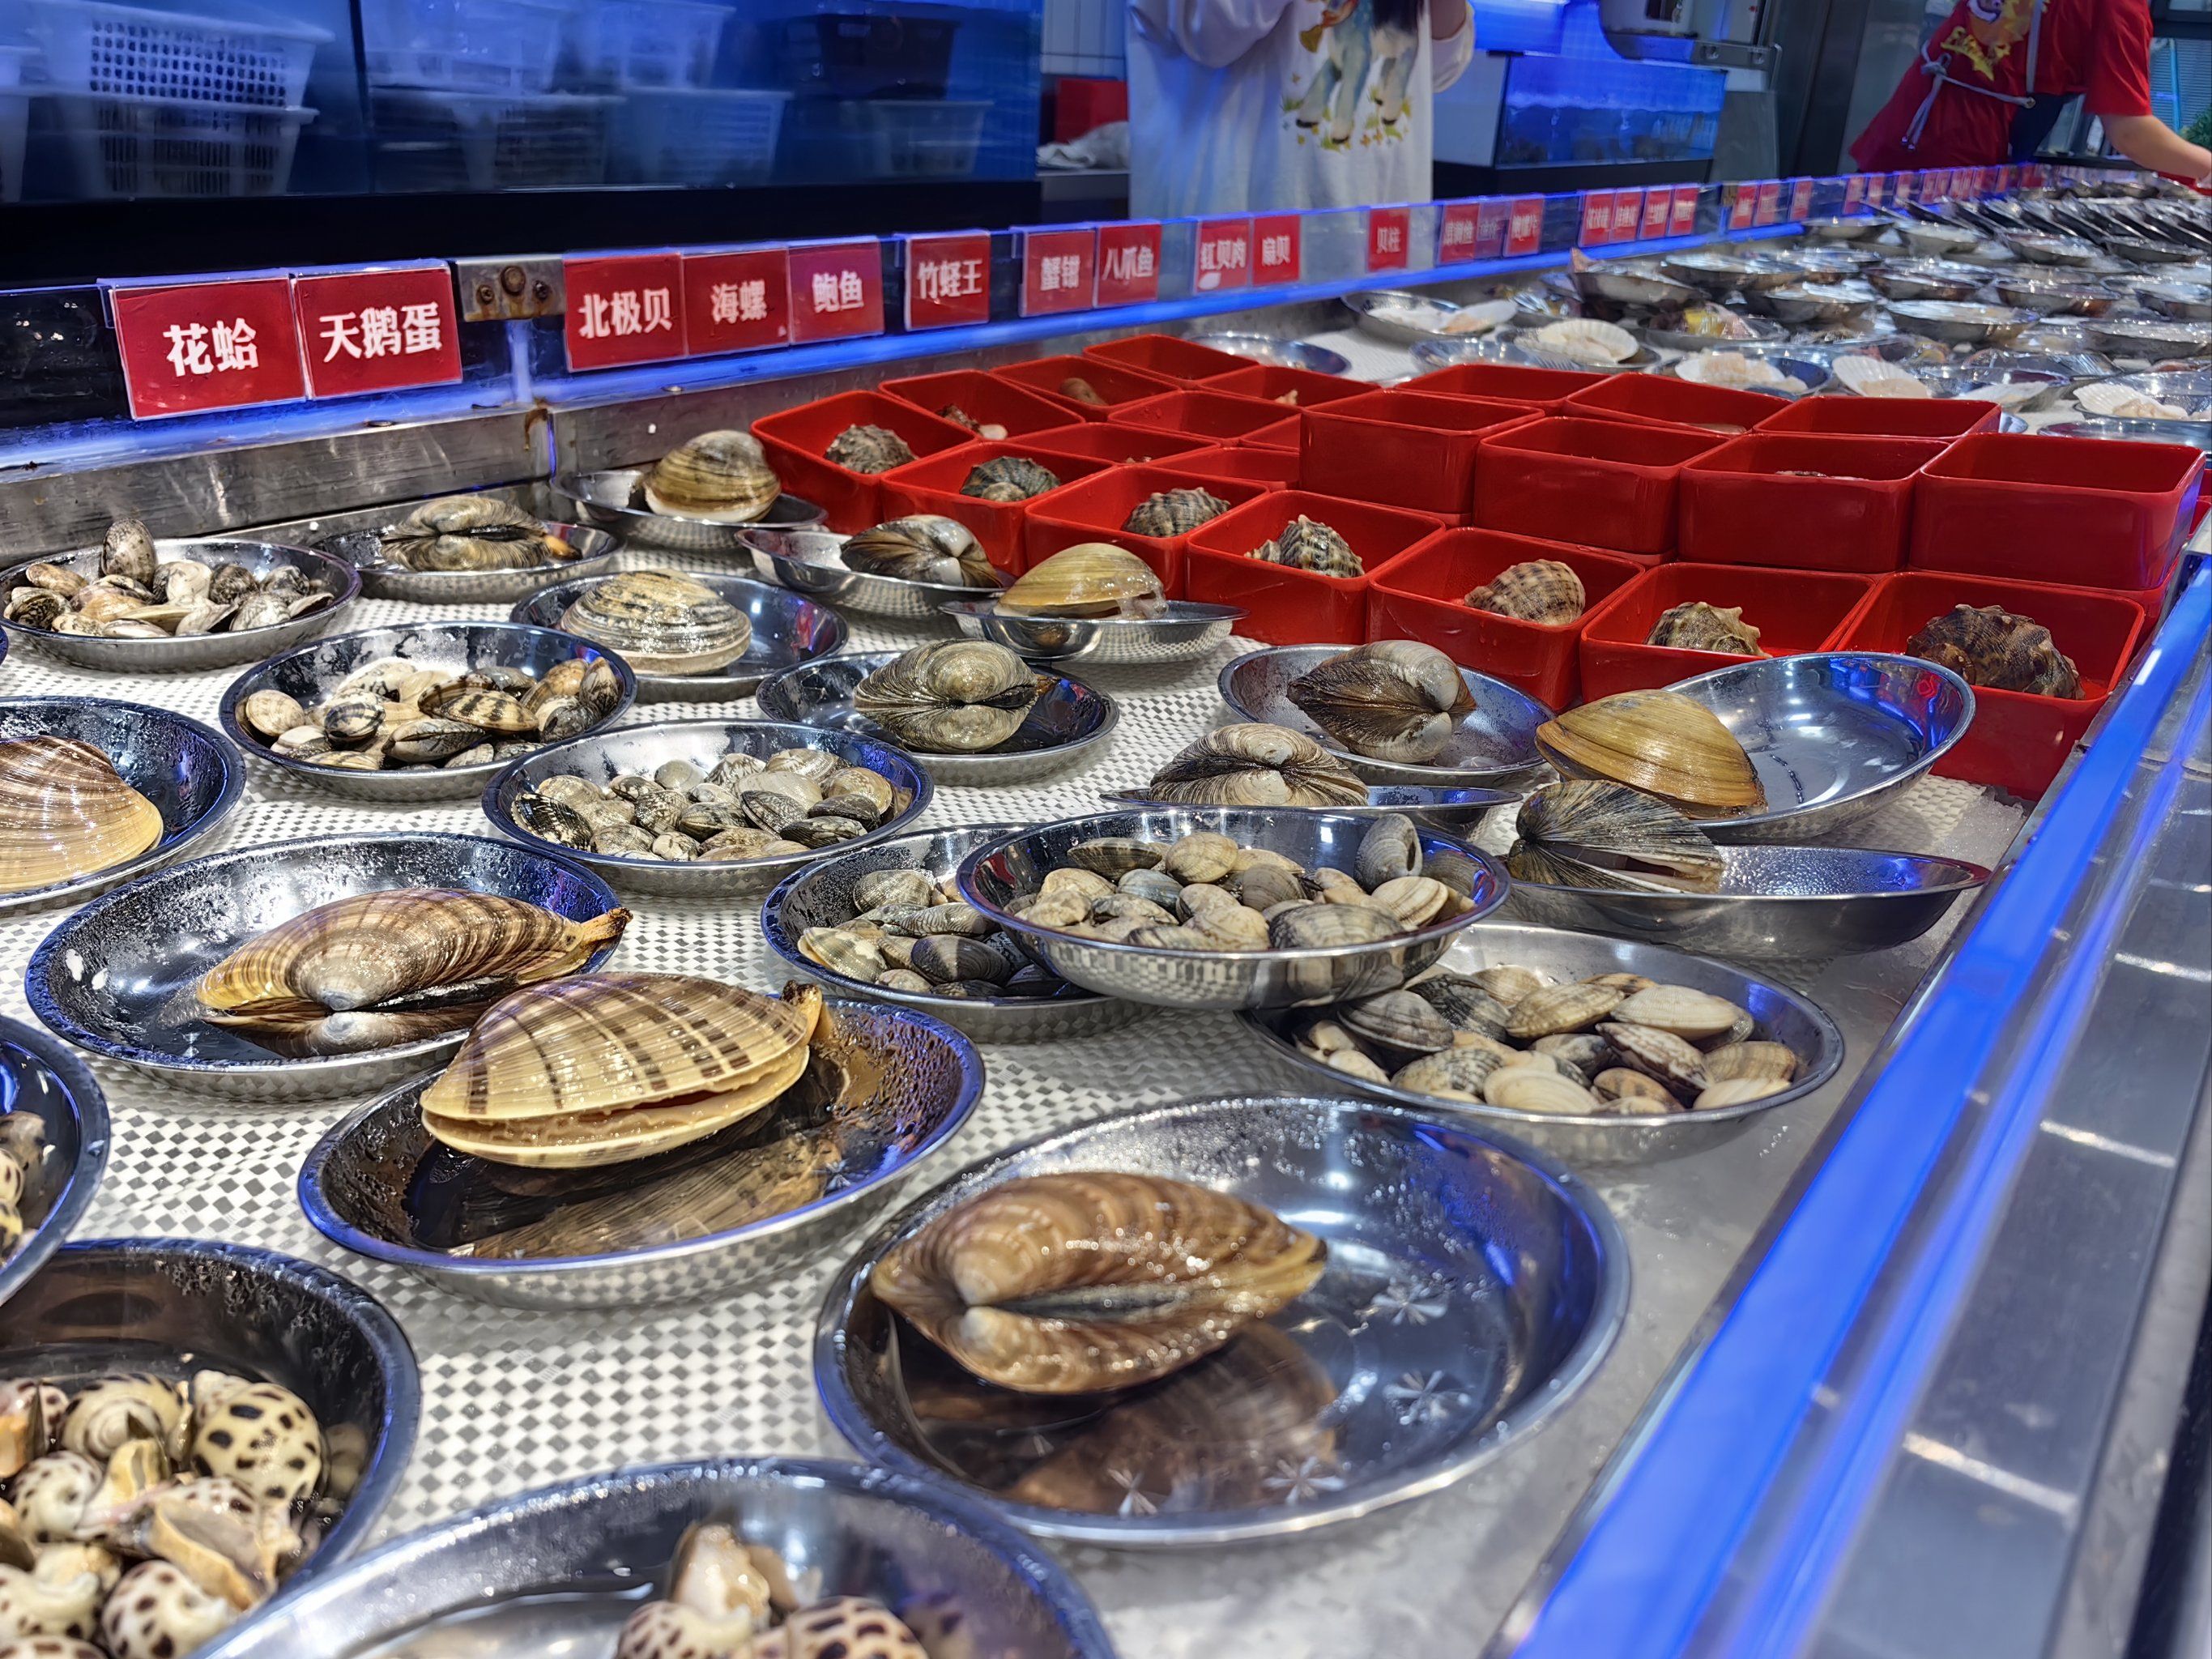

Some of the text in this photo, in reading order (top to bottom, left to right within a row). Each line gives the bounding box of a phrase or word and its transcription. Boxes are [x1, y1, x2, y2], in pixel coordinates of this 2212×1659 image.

[918, 259, 982, 300] 竹蛏王
[1102, 245, 1153, 284] 八爪鱼
[578, 288, 672, 339] 北极贝
[711, 279, 768, 324] 海螺
[812, 271, 864, 313] 鲍鱼
[163, 318, 259, 377] 花蛤
[319, 301, 442, 363] 天鹅蛋
